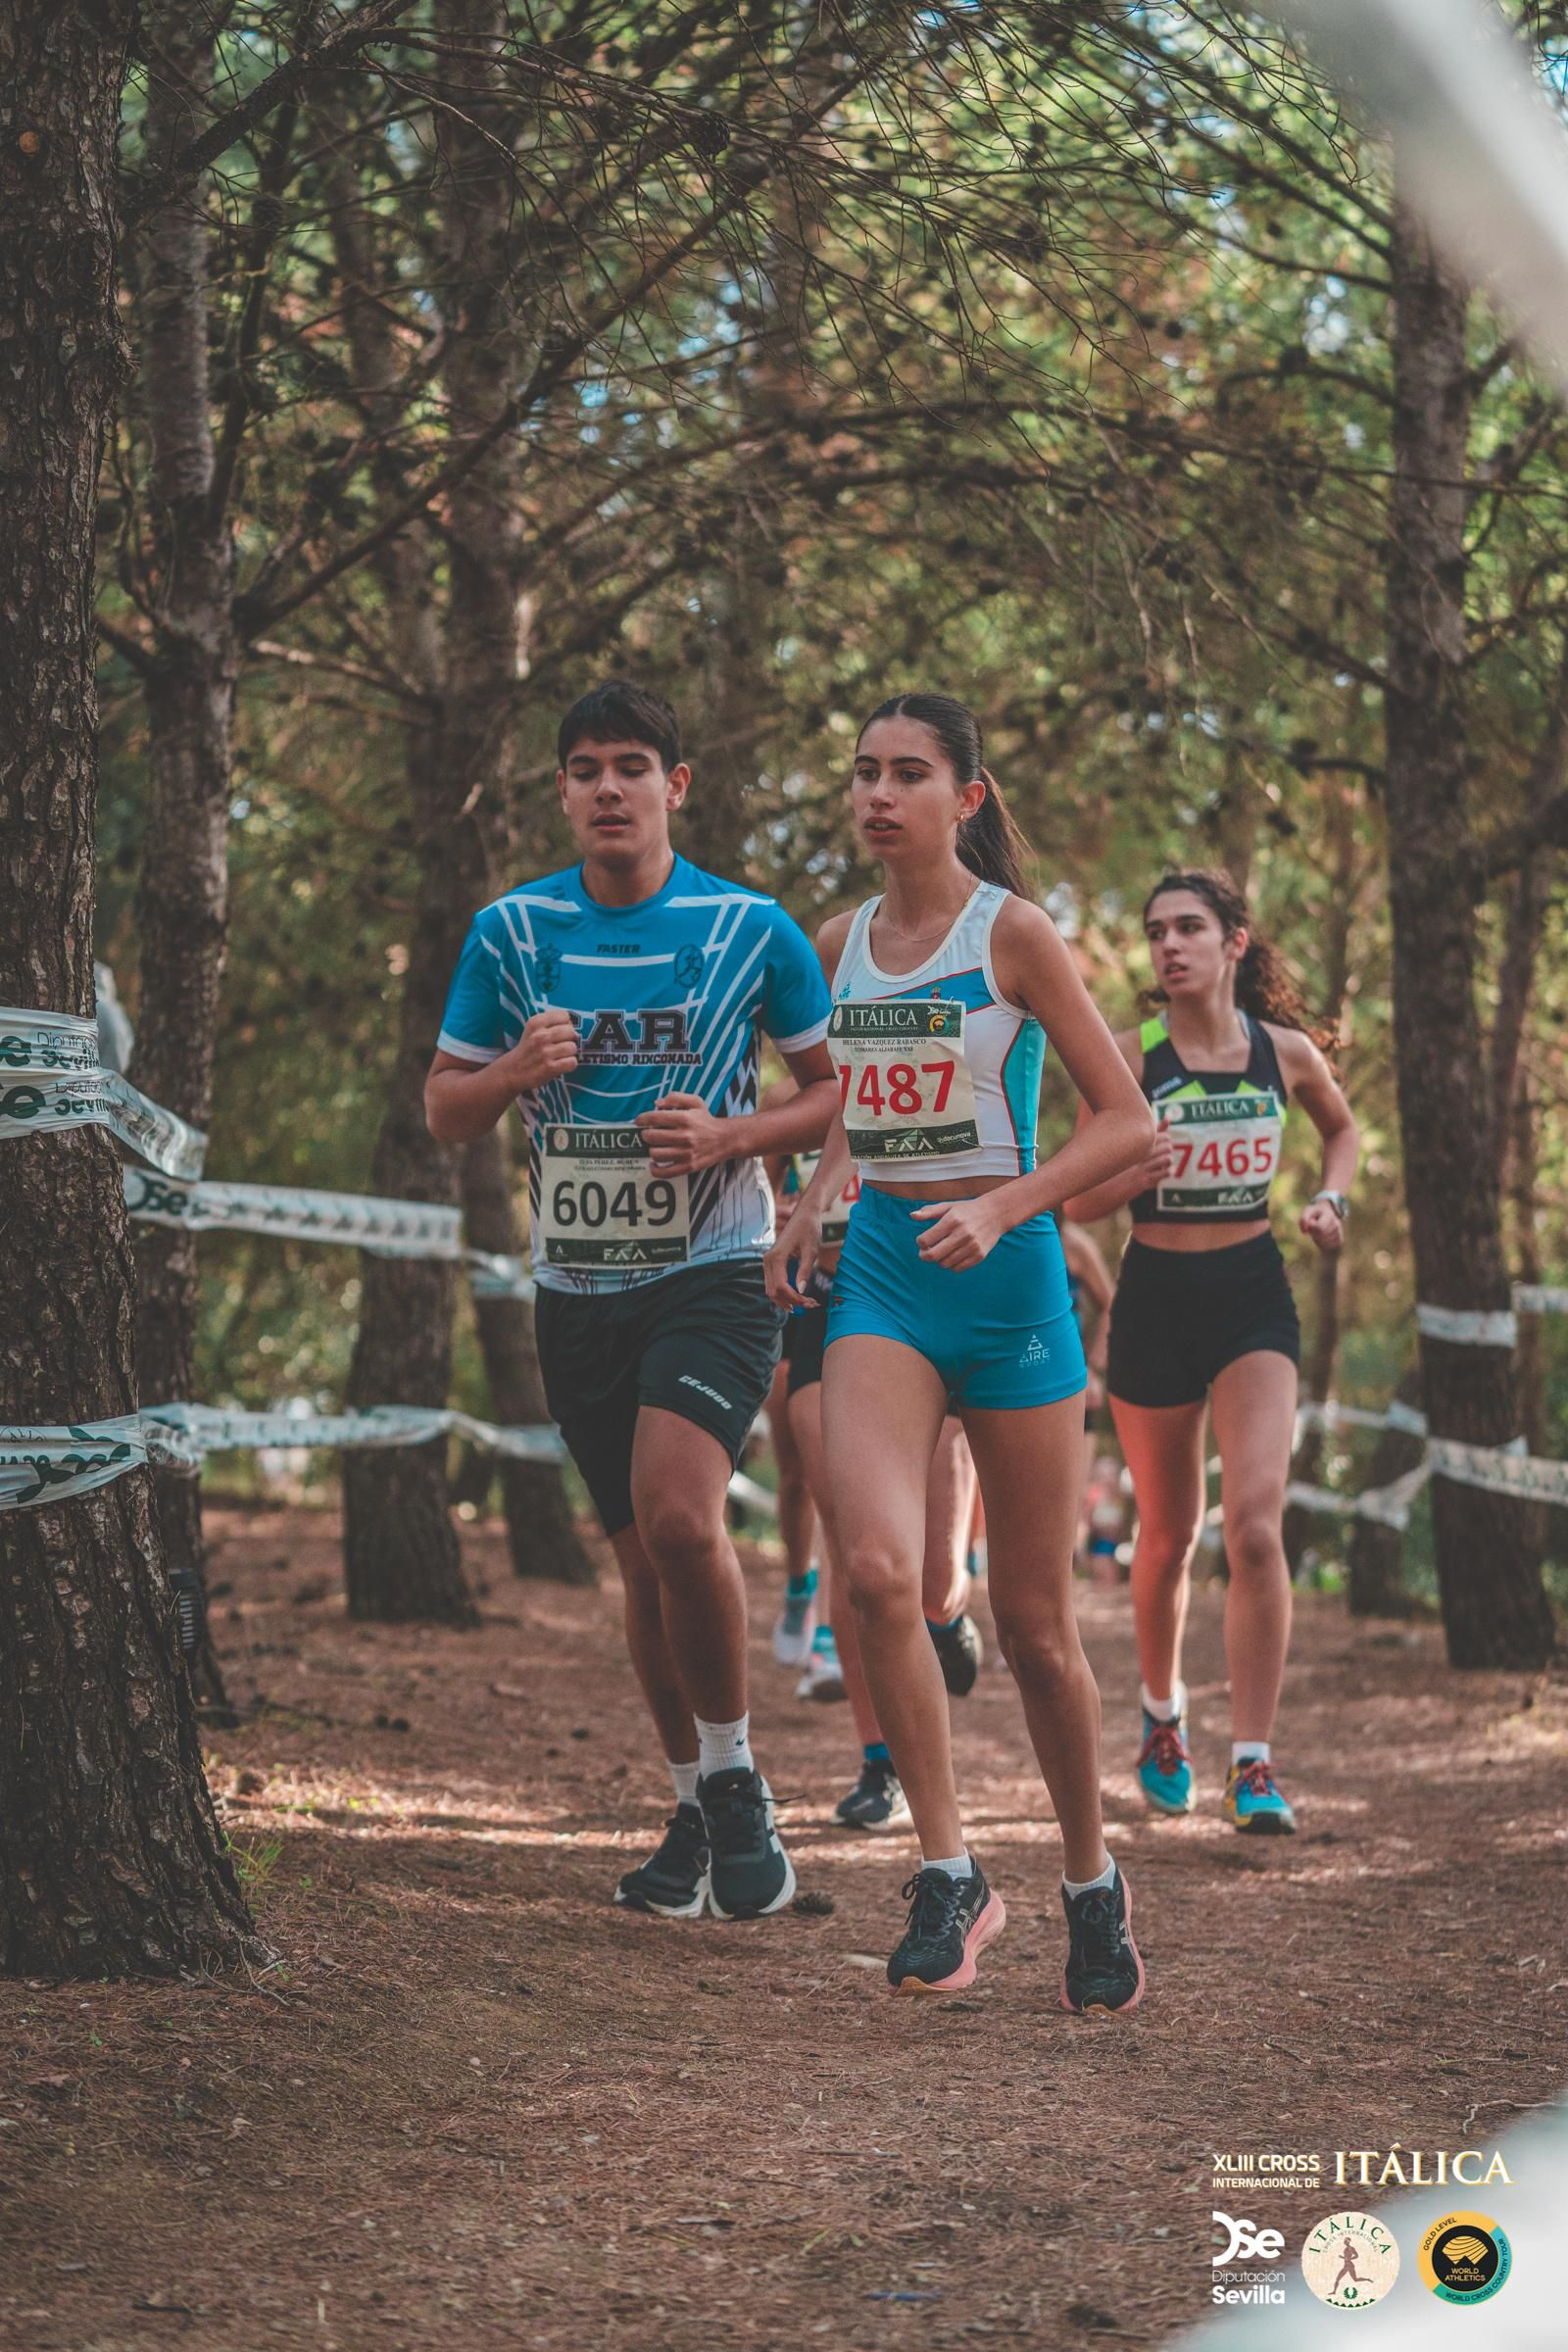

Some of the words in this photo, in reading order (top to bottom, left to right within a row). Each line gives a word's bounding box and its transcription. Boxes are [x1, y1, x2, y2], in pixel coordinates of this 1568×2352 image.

[597, 944, 641, 954] FASTER
[850, 1005, 918, 1026] ITÁLICA
[569, 1009, 690, 1053] AR
[632, 1053, 702, 1065] RINCONADA
[575, 1130, 643, 1149] ITÁLICA
[1173, 1138, 1273, 1179] 7465
[553, 1180, 676, 1227] 6049
[1019, 1348, 1050, 1362] AIRE
[678, 1375, 732, 1409] CEJUDO
